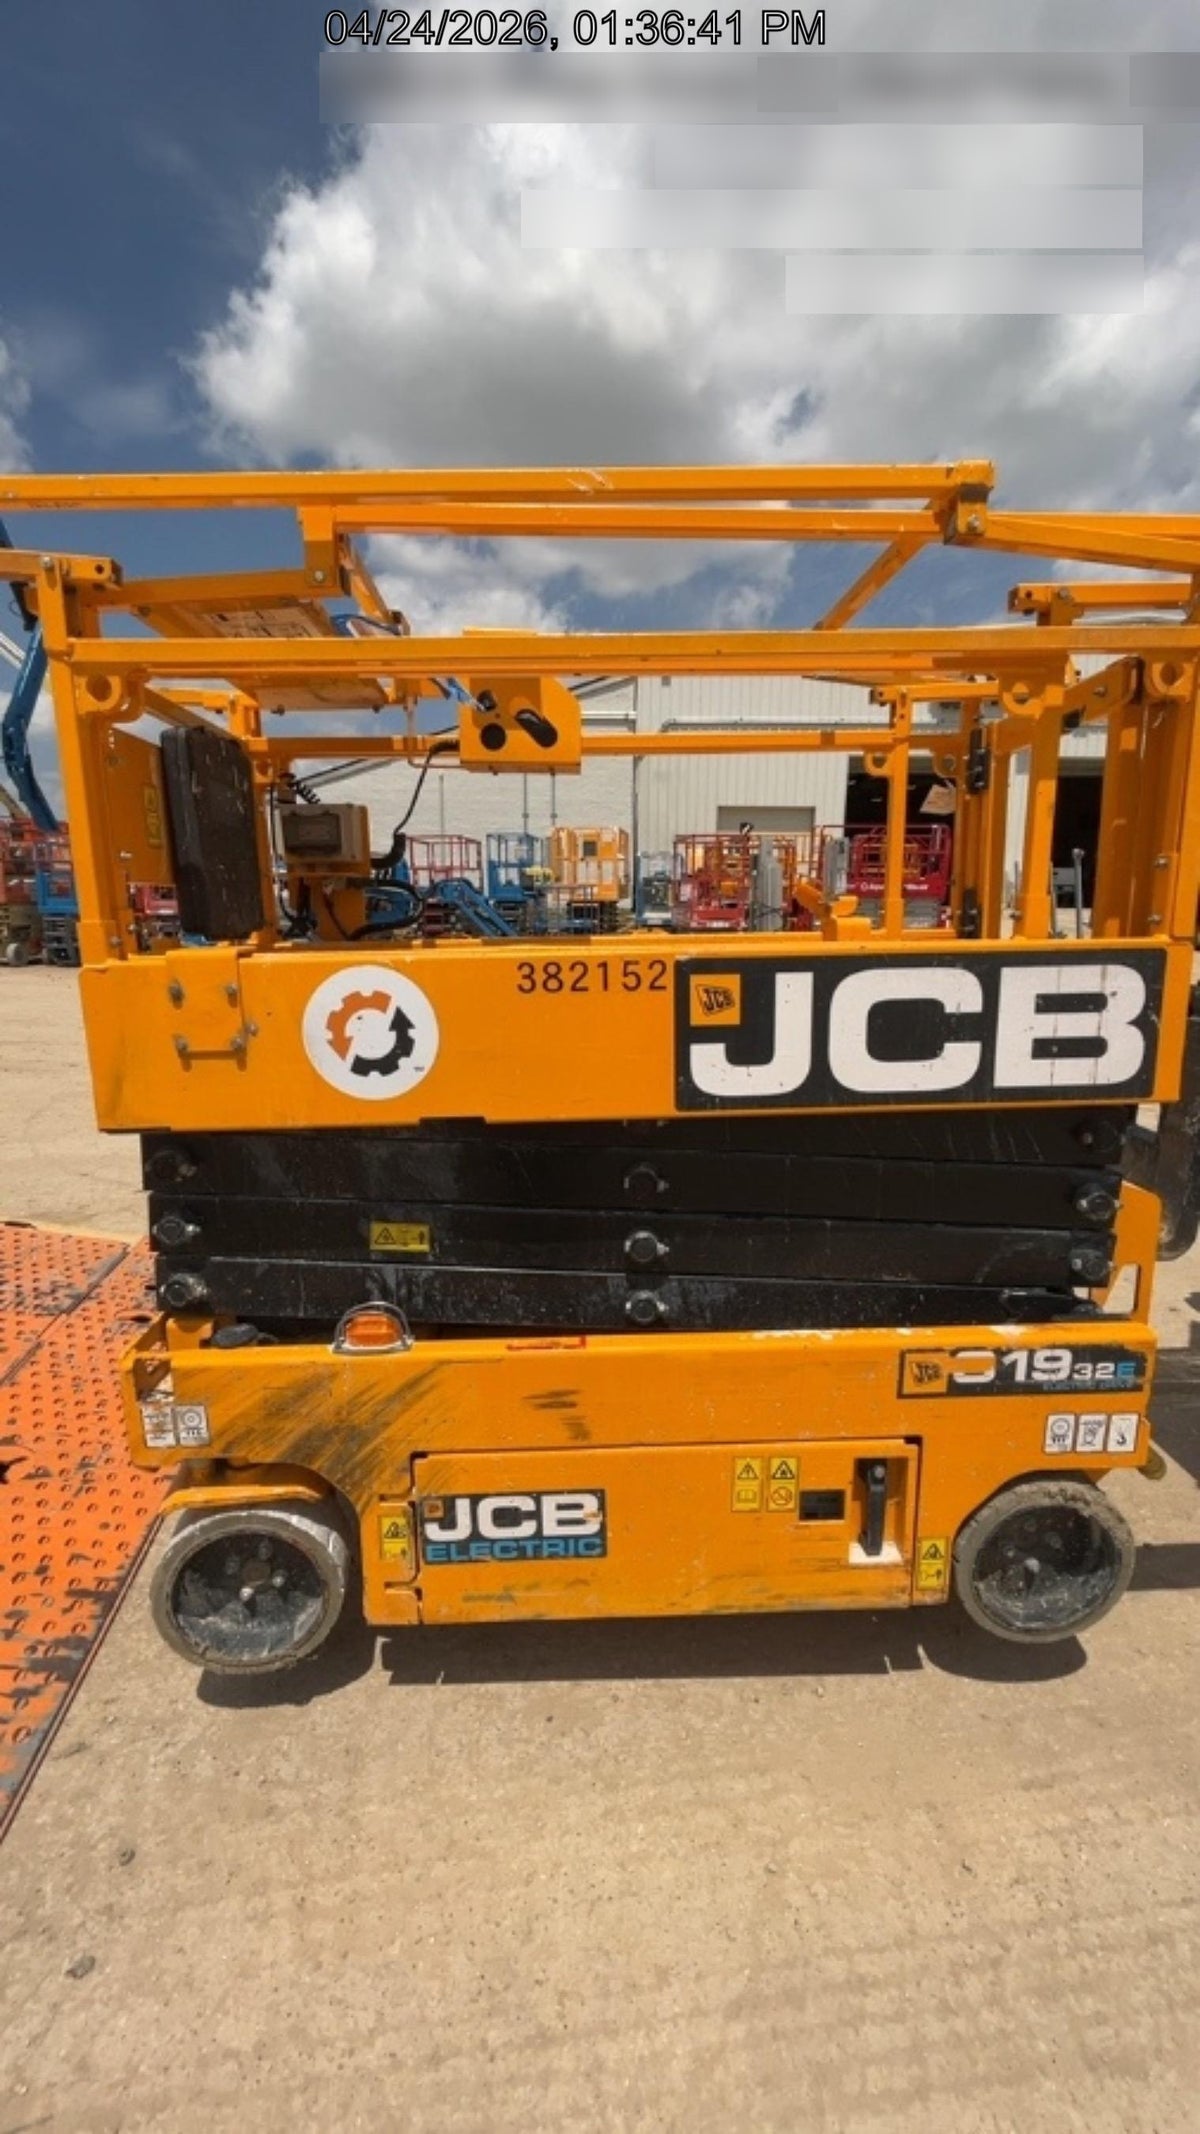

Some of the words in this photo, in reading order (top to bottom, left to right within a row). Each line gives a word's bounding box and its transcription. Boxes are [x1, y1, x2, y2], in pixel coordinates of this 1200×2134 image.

[516, 959, 668, 994] 382152
[689, 964, 1147, 1096] JCB
[424, 1493, 603, 1542] JCB
[425, 1537, 602, 1563] ELECTRIC
